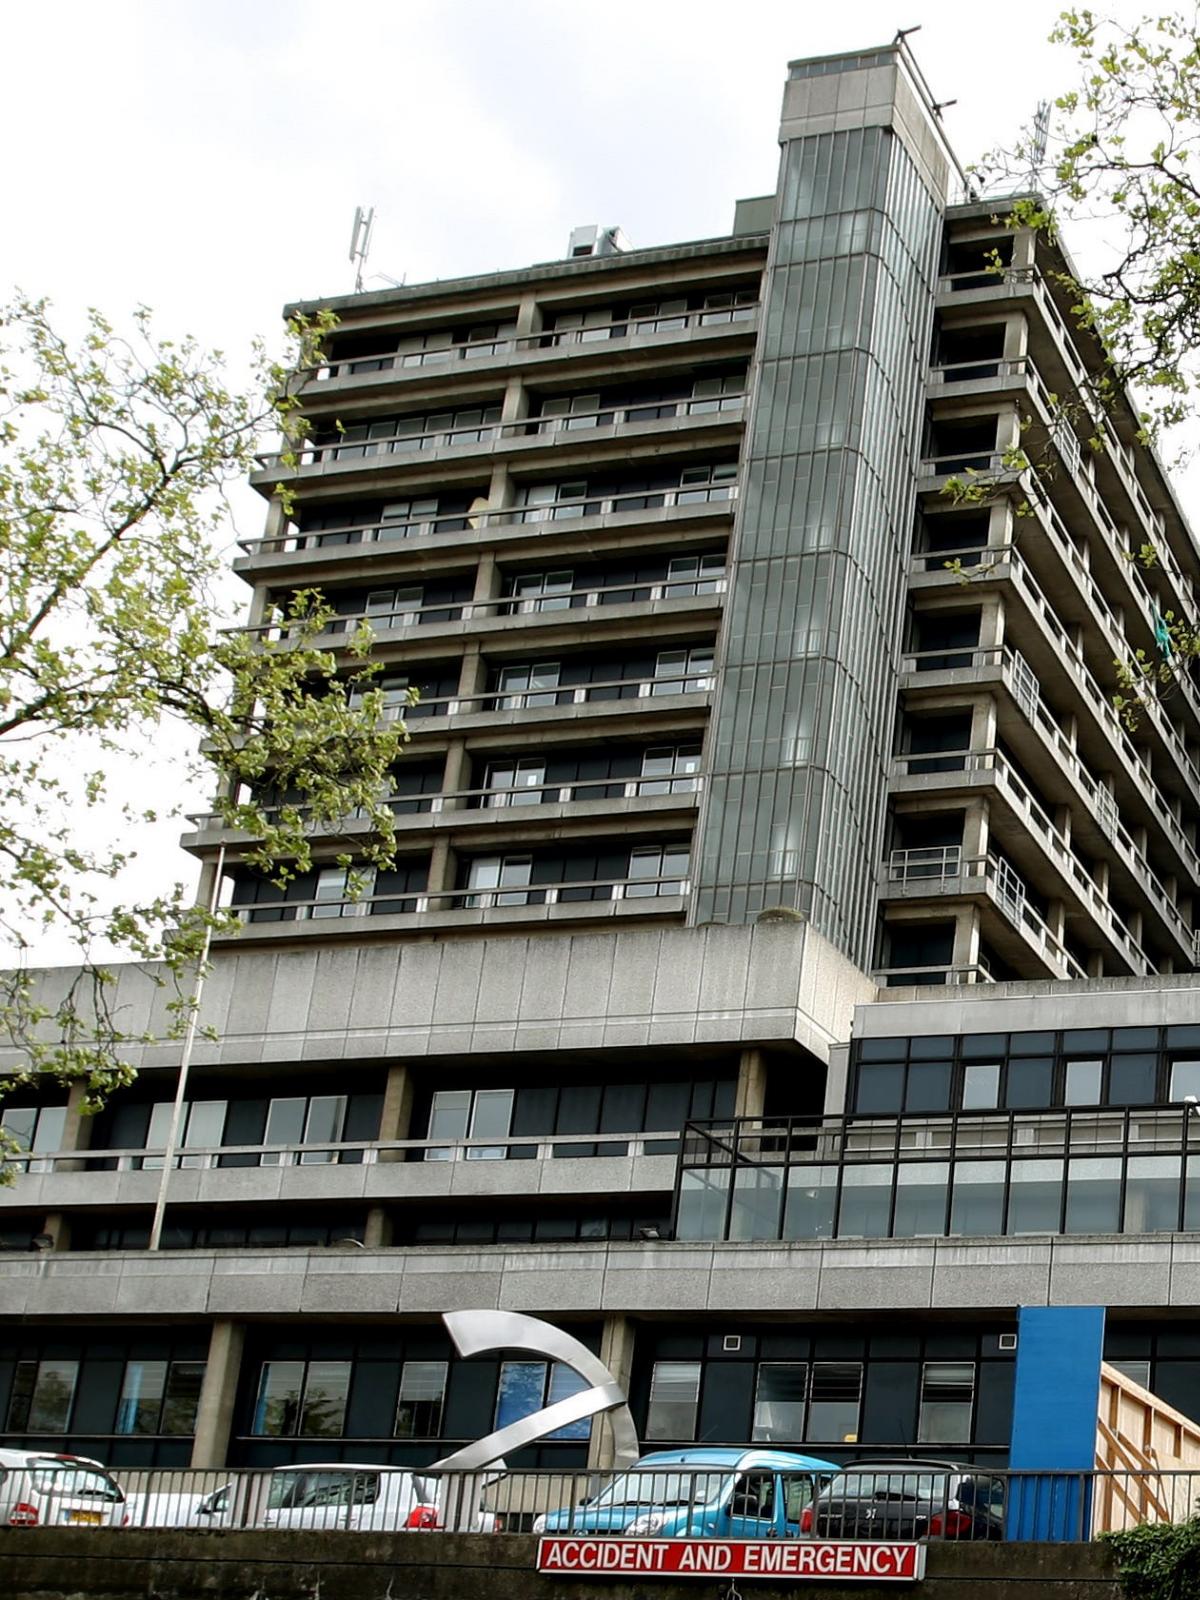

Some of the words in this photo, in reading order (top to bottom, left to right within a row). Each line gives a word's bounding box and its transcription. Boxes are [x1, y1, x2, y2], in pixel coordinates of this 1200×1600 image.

[546, 1542, 669, 1569] ACCIDENT
[678, 1545, 732, 1571] AND
[743, 1545, 909, 1573] EMERGENCY
